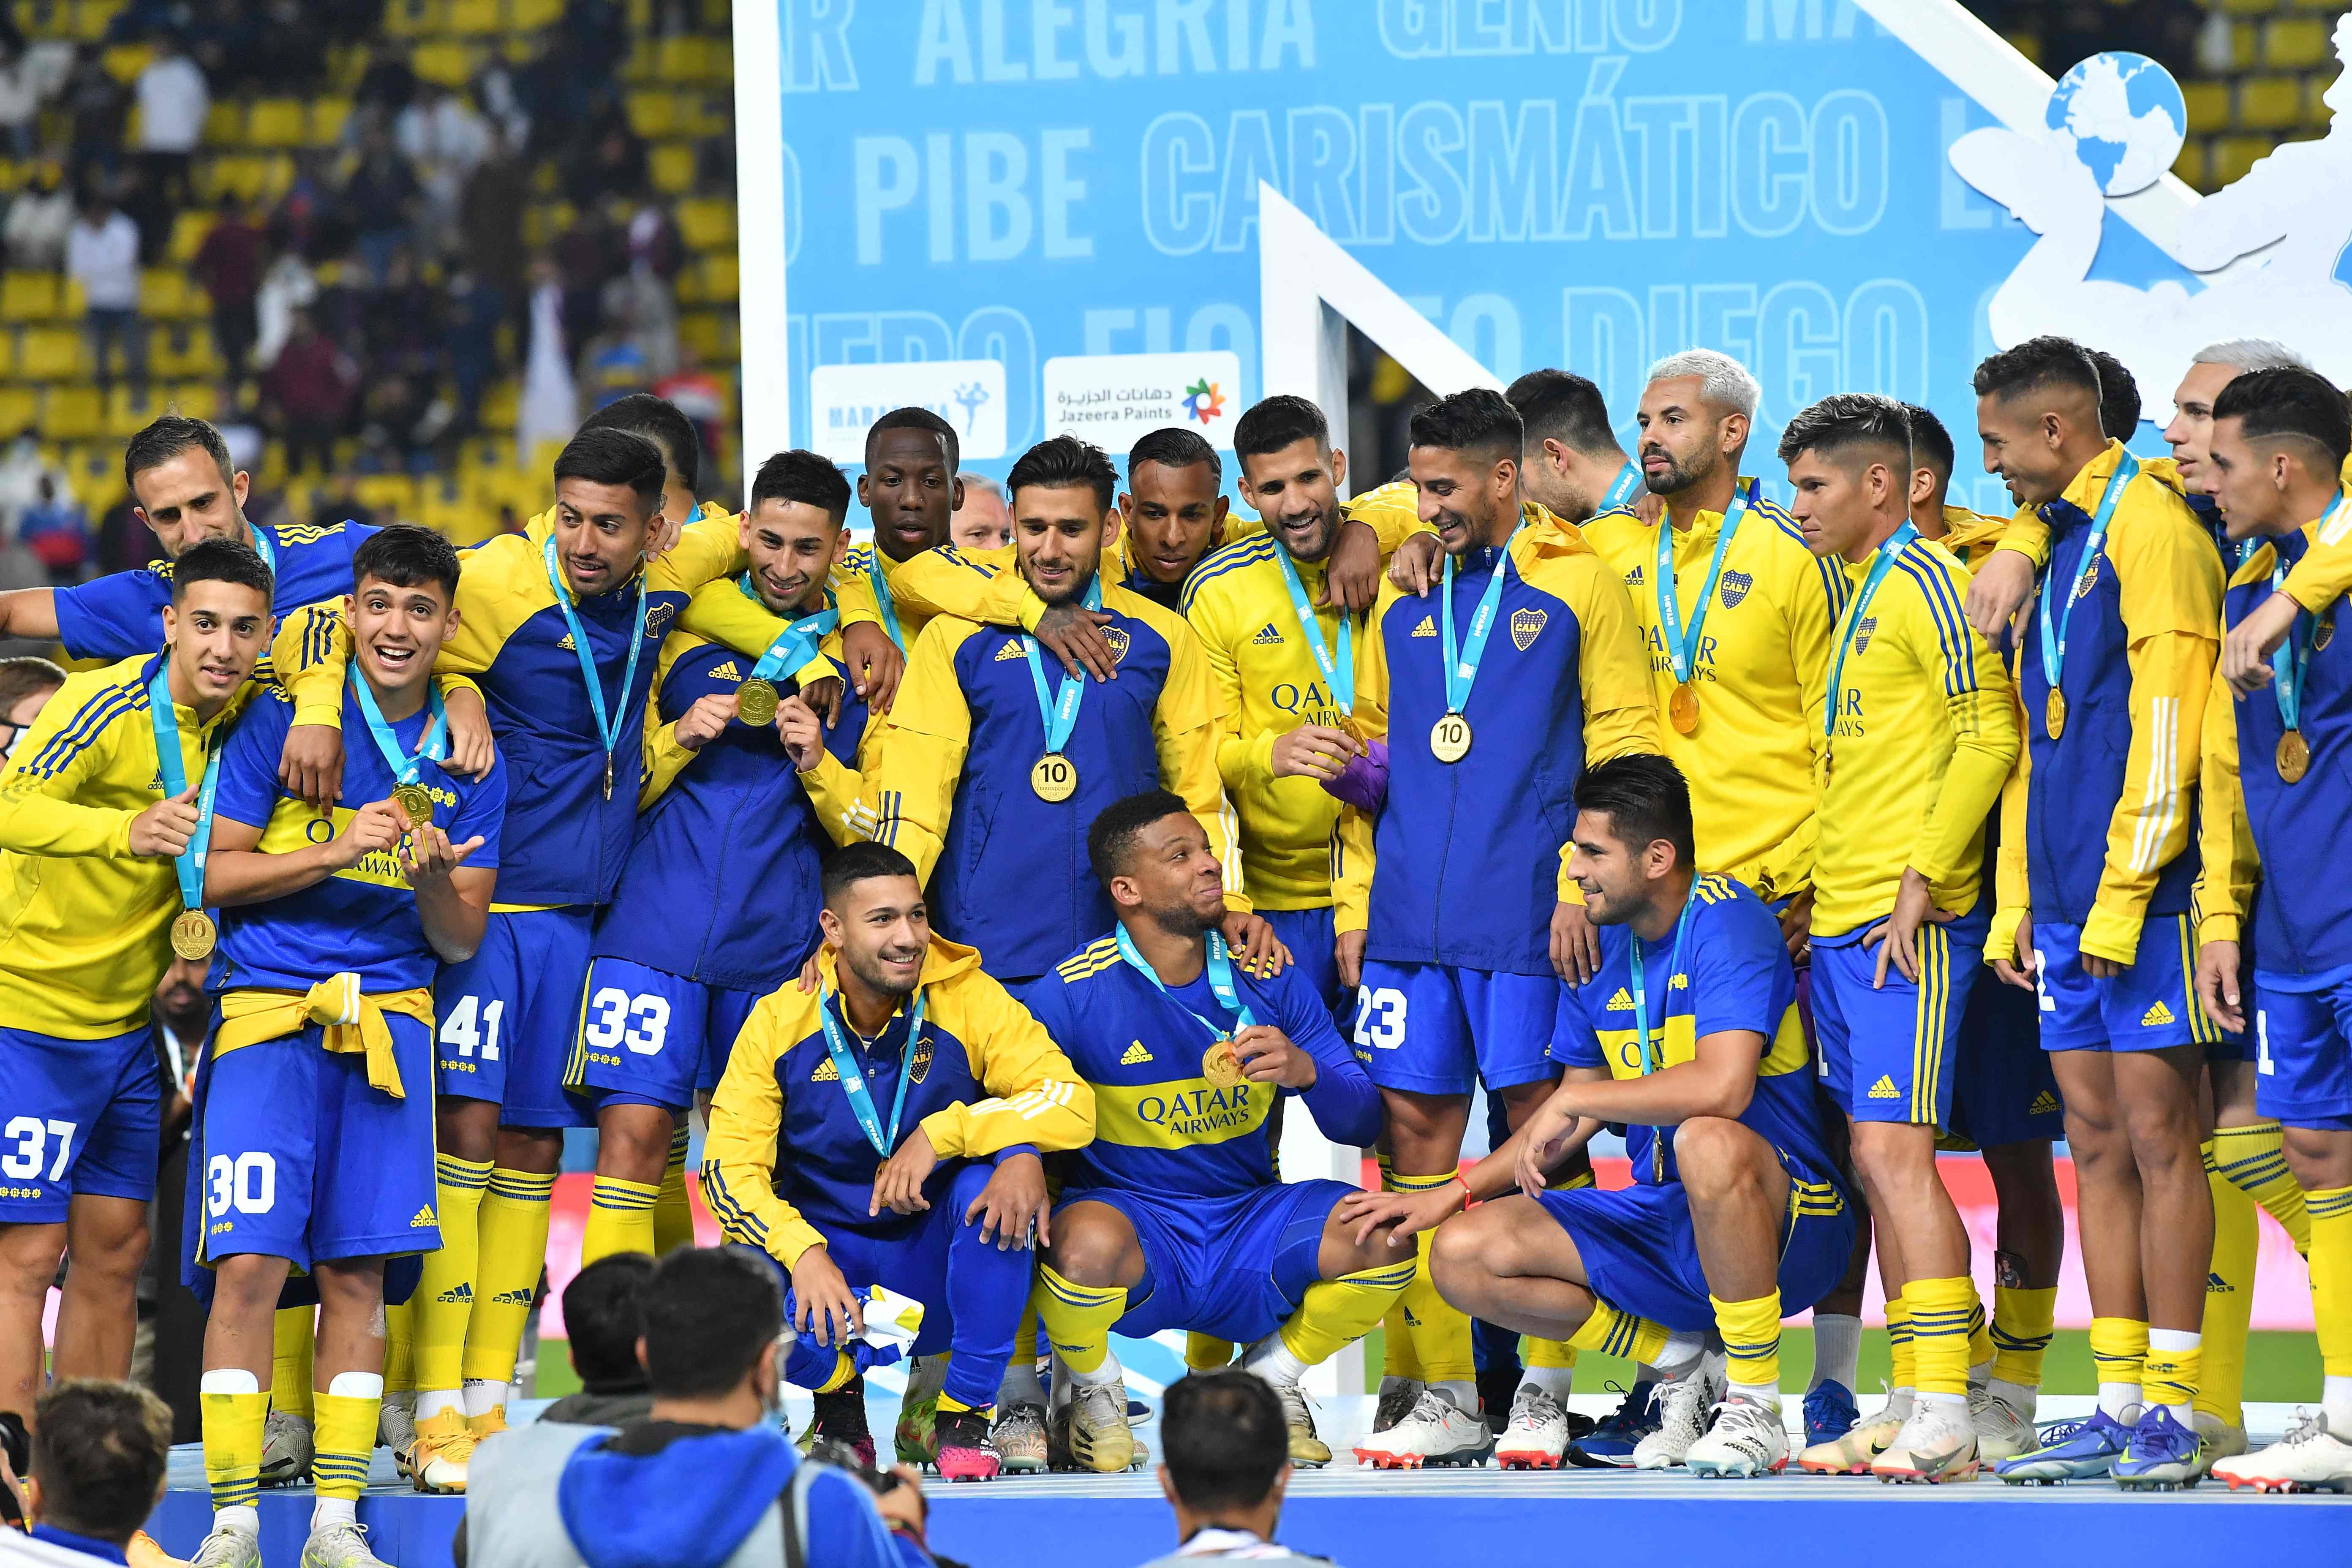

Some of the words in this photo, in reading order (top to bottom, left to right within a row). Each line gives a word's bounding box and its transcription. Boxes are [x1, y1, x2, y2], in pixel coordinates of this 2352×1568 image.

[855, 128, 1093, 265] PIBE
[1141, 55, 1889, 256] CARISMÁTICO
[1117, 389, 1172, 402] دهانات
[1059, 409, 1119, 422] Jazeera
[1125, 407, 1172, 419] Paints
[1613, 472, 1635, 501] RIYADH
[2110, 474, 2129, 504] RIYADH
[1723, 581, 1748, 593] CABJ
[1858, 582, 1876, 613] RIYADH
[2067, 574, 2083, 609] RIYADH
[1473, 605, 1489, 637] RIYADH
[1664, 594, 1674, 626] RIYADH
[1252, 637, 1285, 645] adidas
[1411, 629, 1437, 637] adidas
[1515, 623, 1541, 632] CABJ
[994, 651, 1027, 662] adidas
[1315, 644, 1334, 673] RIYADH
[708, 671, 742, 682] adidas
[1061, 689, 1075, 720] RIYADH
[1439, 724, 1462, 743] 10
[1040, 763, 1067, 783] 10
[199, 789, 210, 822] RIYADH
[179, 919, 207, 939] 10
[1210, 931, 1221, 960] RIYADH
[440, 996, 504, 1061] 41
[585, 988, 671, 1056] 33
[1353, 985, 1407, 1049] 23
[2142, 1015, 2175, 1026] adidas
[829, 1021, 843, 1053] RIYADH
[912, 1052, 931, 1064] ABJ
[1120, 1054, 1153, 1065] adidas
[811, 1072, 839, 1082] adida
[1138, 1085, 1249, 1126] QATAR
[1868, 1089, 1900, 1098] adidas
[866, 1119, 883, 1150] RIYADH
[1170, 1108, 1249, 1135] AIRWAYS
[1, 1116, 77, 1182] 37
[208, 1152, 276, 1218] 30
